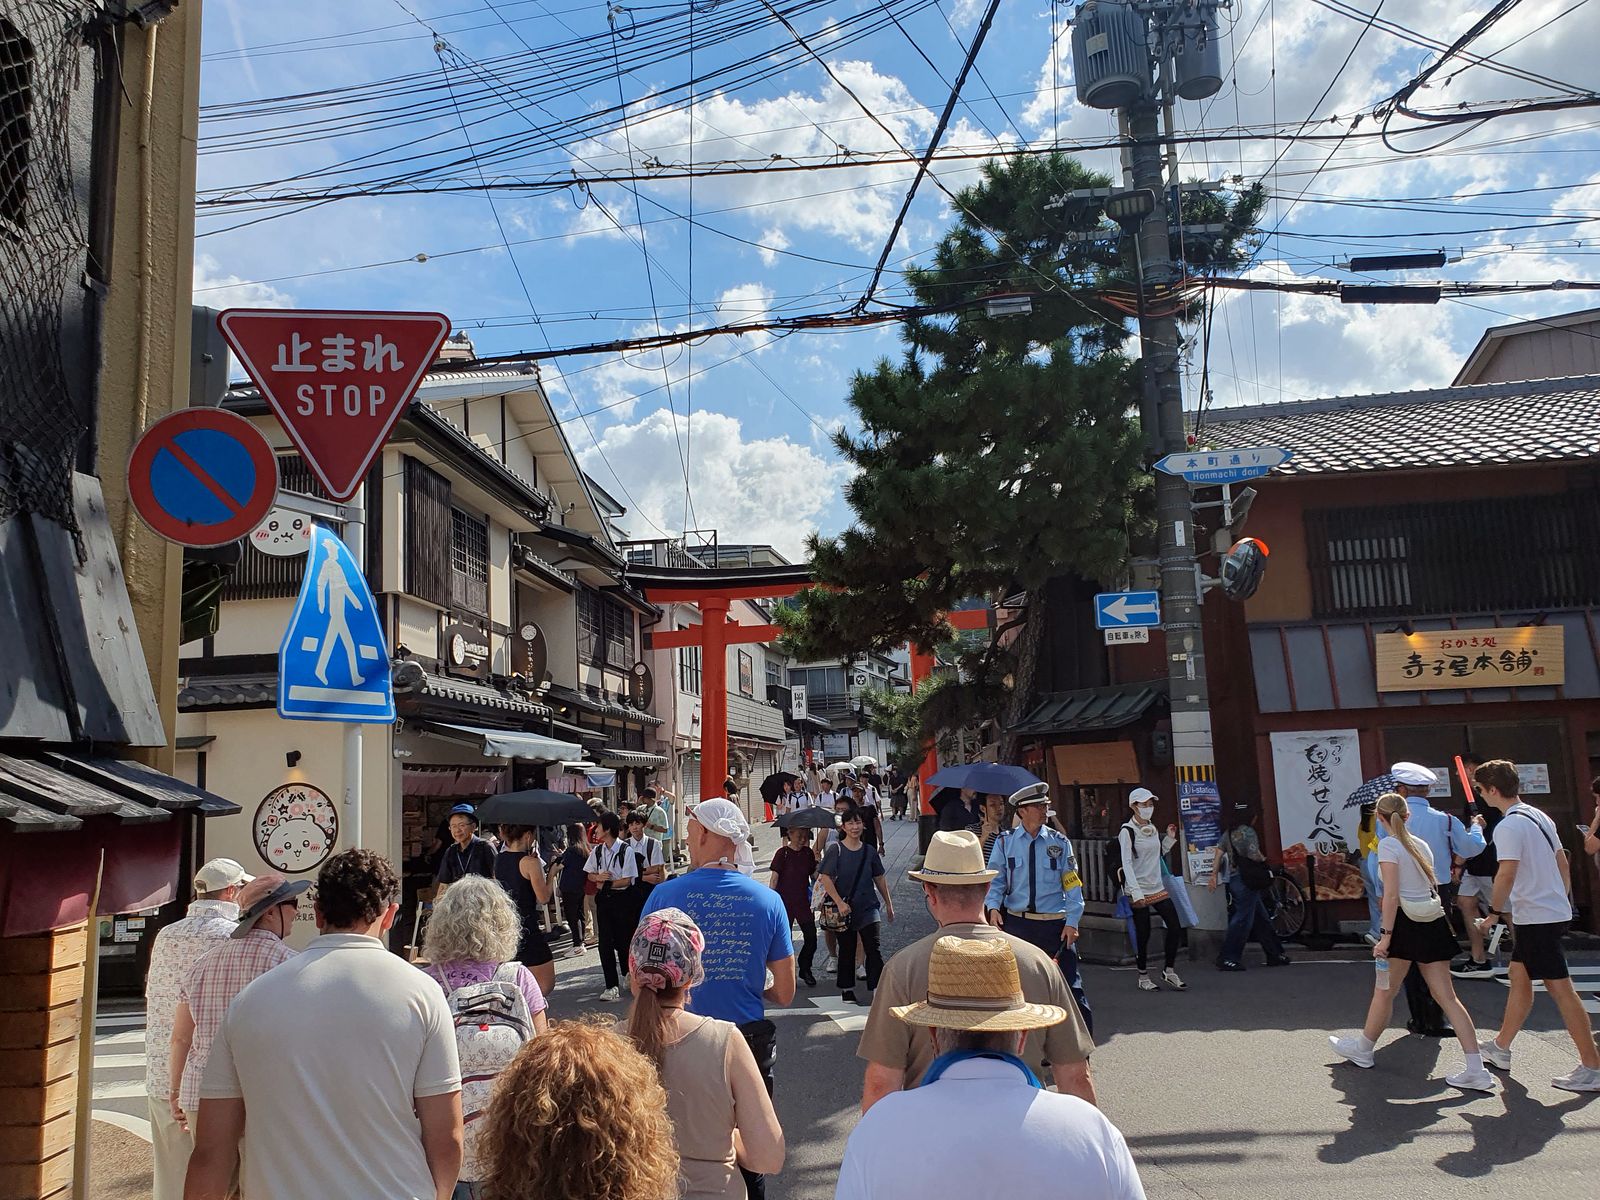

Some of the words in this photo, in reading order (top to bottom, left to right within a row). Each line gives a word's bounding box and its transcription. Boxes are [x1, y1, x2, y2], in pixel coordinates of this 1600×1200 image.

[271, 333, 404, 373] 止まれ
[297, 384, 386, 416] STOP
[1186, 453, 1260, 469] 本町通り
[1192, 470, 1237, 480] Honmachi
[1242, 468, 1259, 477] dori
[1107, 630, 1147, 641] 自転車を除く
[1440, 636, 1497, 650] おかき処
[1401, 648, 1538, 679] 寺子屋本舗
[1191, 786, 1216, 794] i-station
